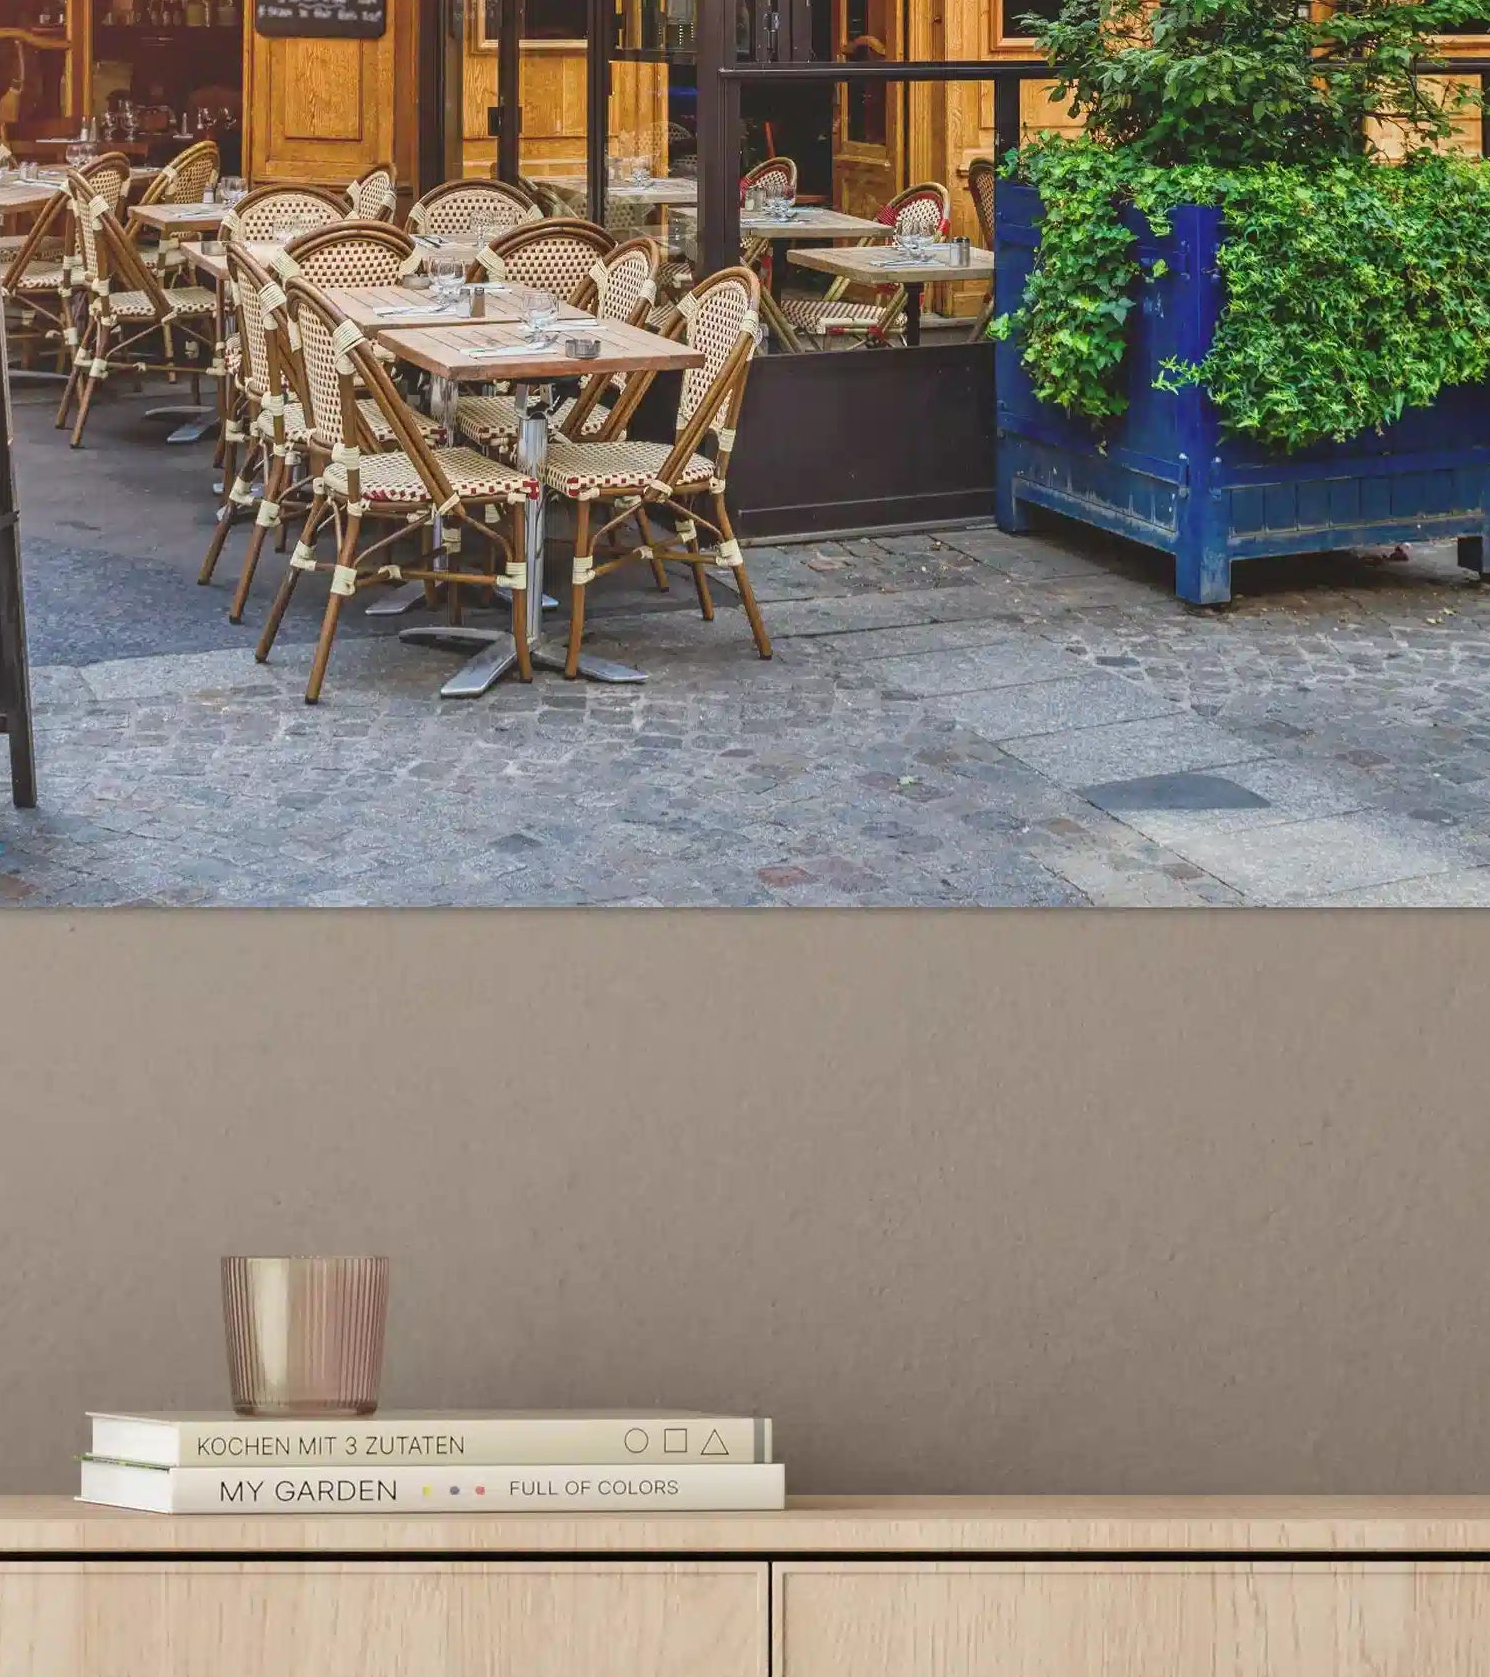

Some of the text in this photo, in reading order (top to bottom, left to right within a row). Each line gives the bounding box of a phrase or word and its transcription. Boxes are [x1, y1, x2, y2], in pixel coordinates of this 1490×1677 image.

[196, 1434, 465, 1457] KOCHEN MIT 3 ZUTATEN
[219, 1479, 398, 1503] MY GARDEN
[509, 1479, 680, 1496] FULL OF COLORS
